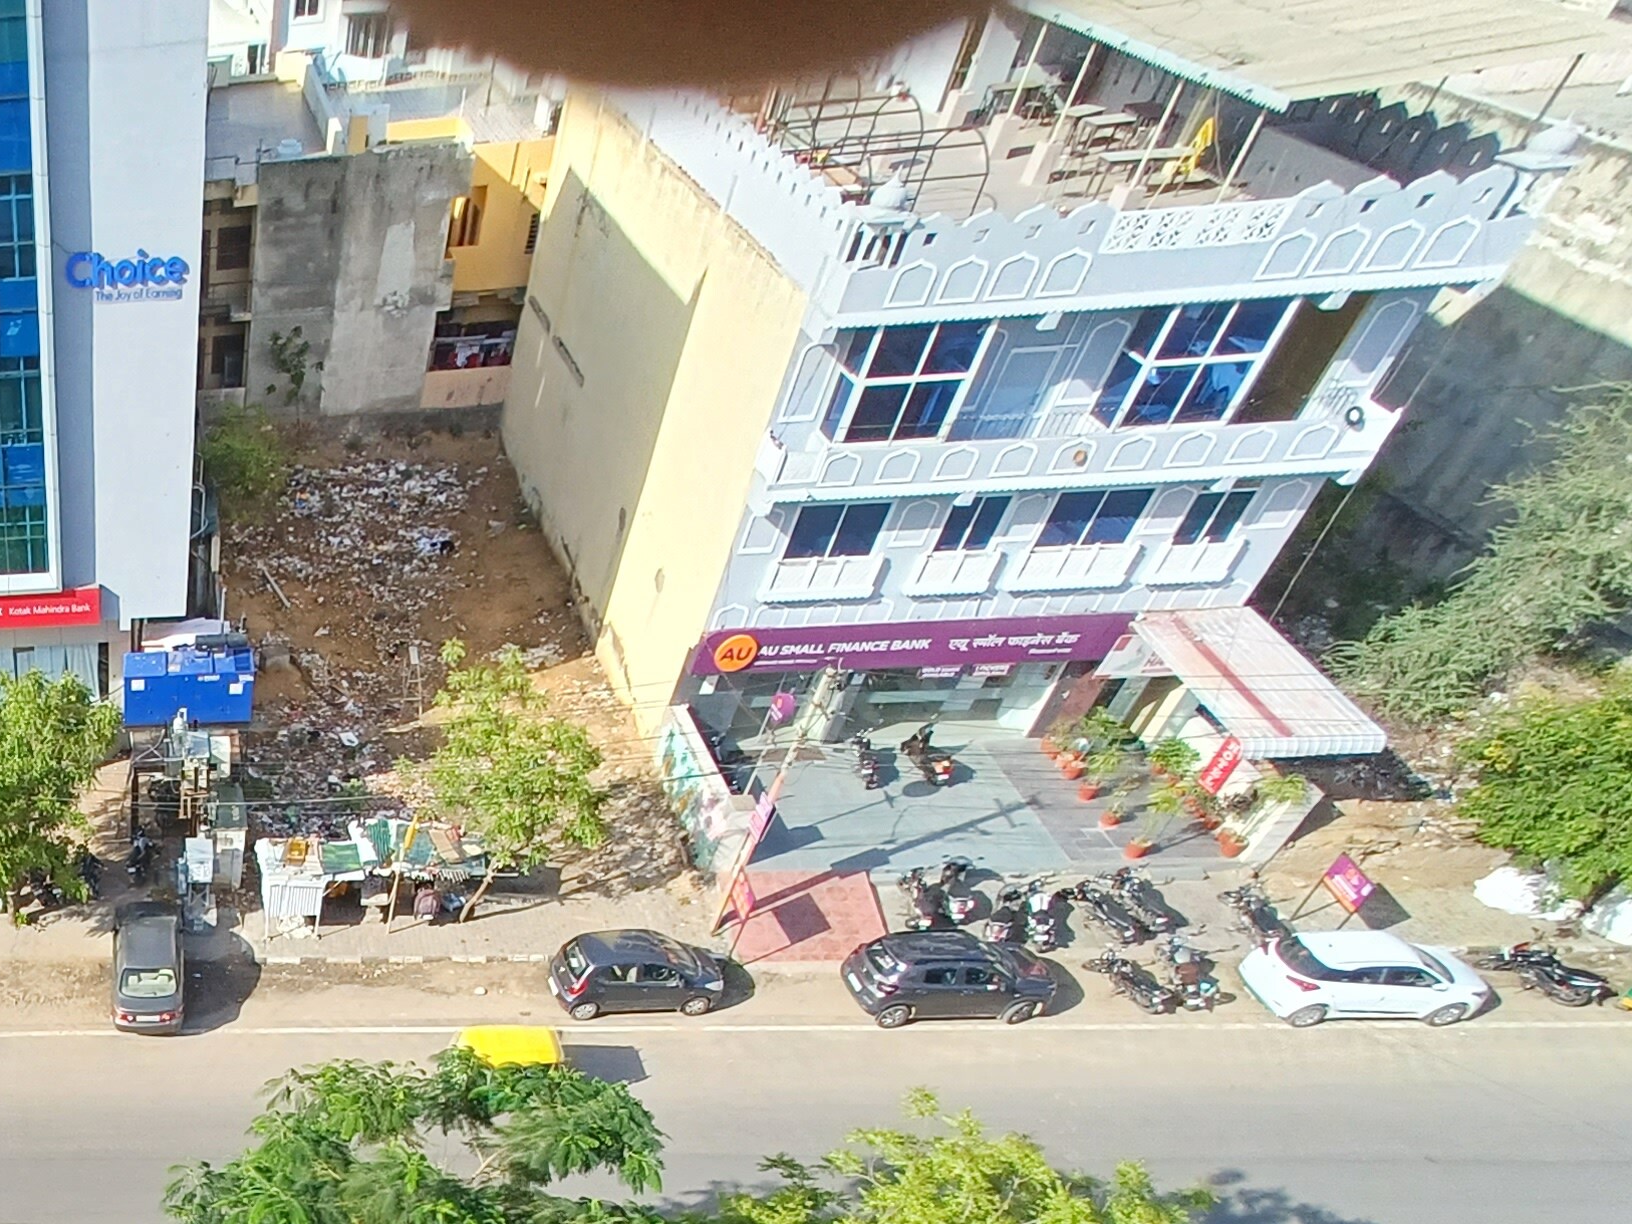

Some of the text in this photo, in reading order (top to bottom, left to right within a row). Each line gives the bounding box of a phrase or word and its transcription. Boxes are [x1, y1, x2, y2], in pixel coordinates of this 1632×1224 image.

[66, 249, 189, 289] Choice
[96, 288, 183, 301] The Joy of Earning
[9, 603, 91, 616] Kotak Mahindra Bank
[719, 647, 752, 662] AU
[757, 638, 932, 657] AU SMALL FINANCE BANK
